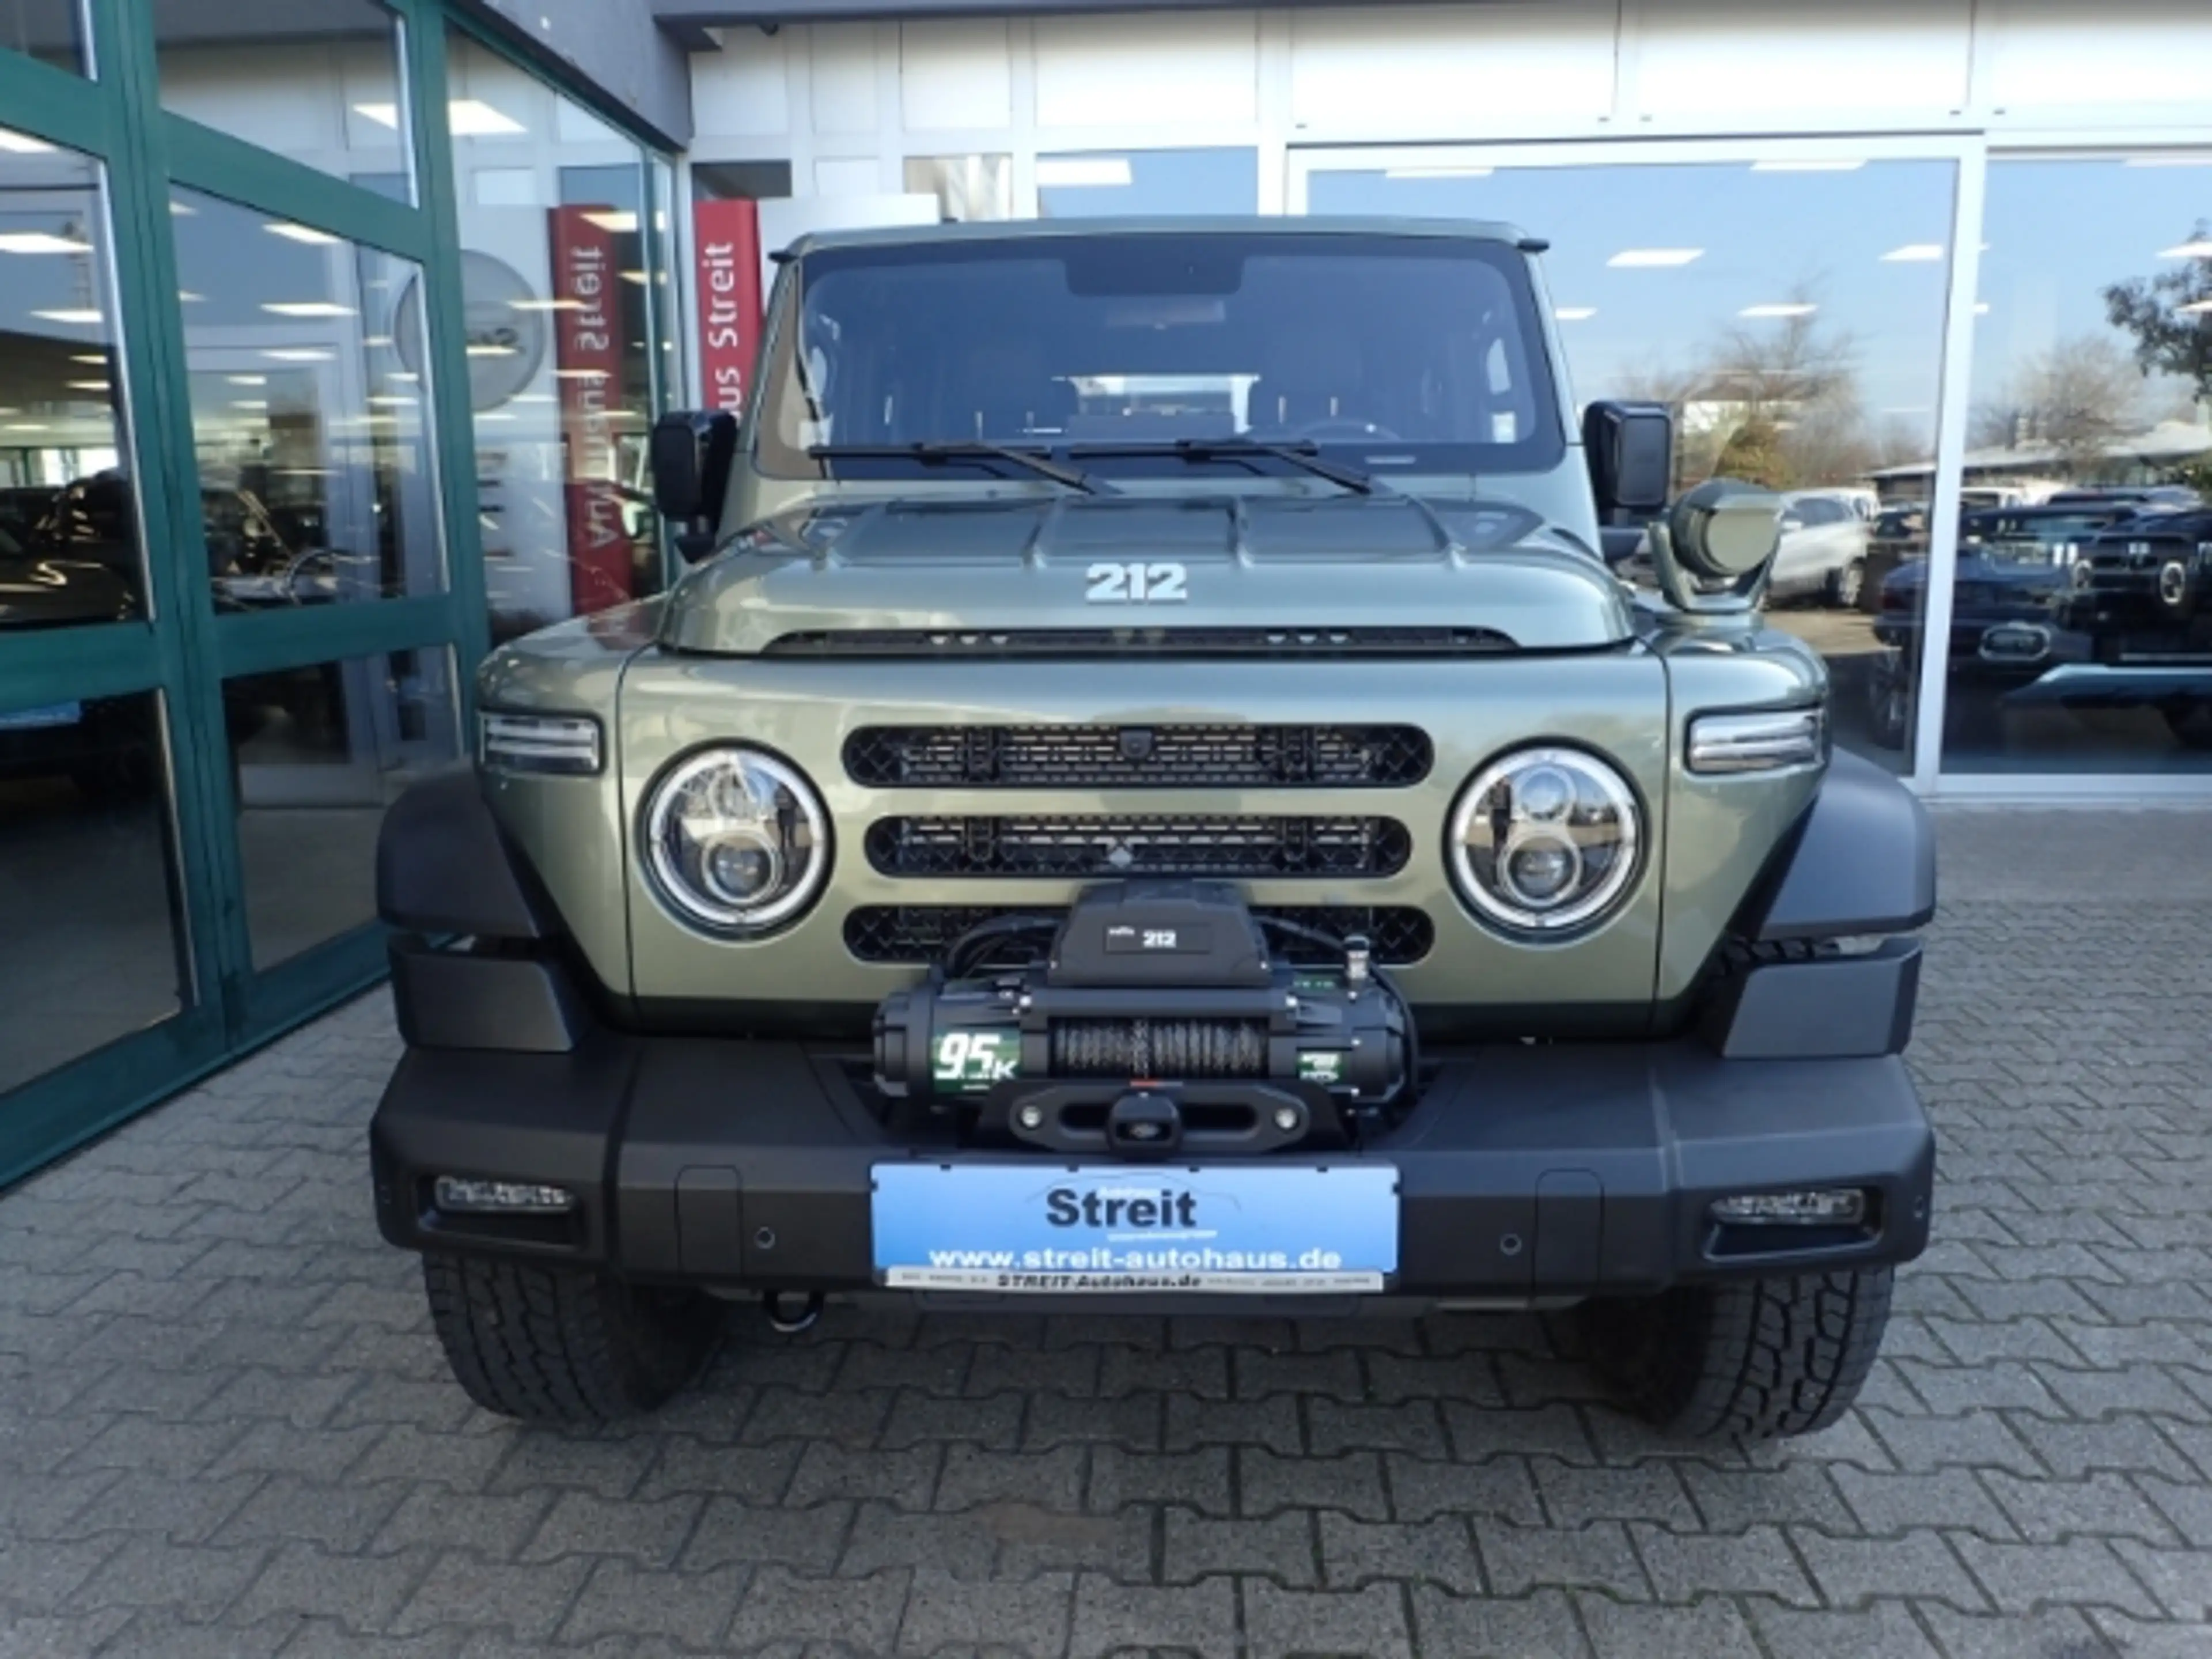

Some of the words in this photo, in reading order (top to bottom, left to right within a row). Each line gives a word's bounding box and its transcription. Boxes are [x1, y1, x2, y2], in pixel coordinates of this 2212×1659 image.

[702, 242, 738, 348] Streit
[1085, 562, 1187, 603] 212
[1143, 928, 1177, 949] 212
[1046, 1187, 1196, 1228] Streit
[929, 1247, 1341, 1270] www.streit-autohaus.de
